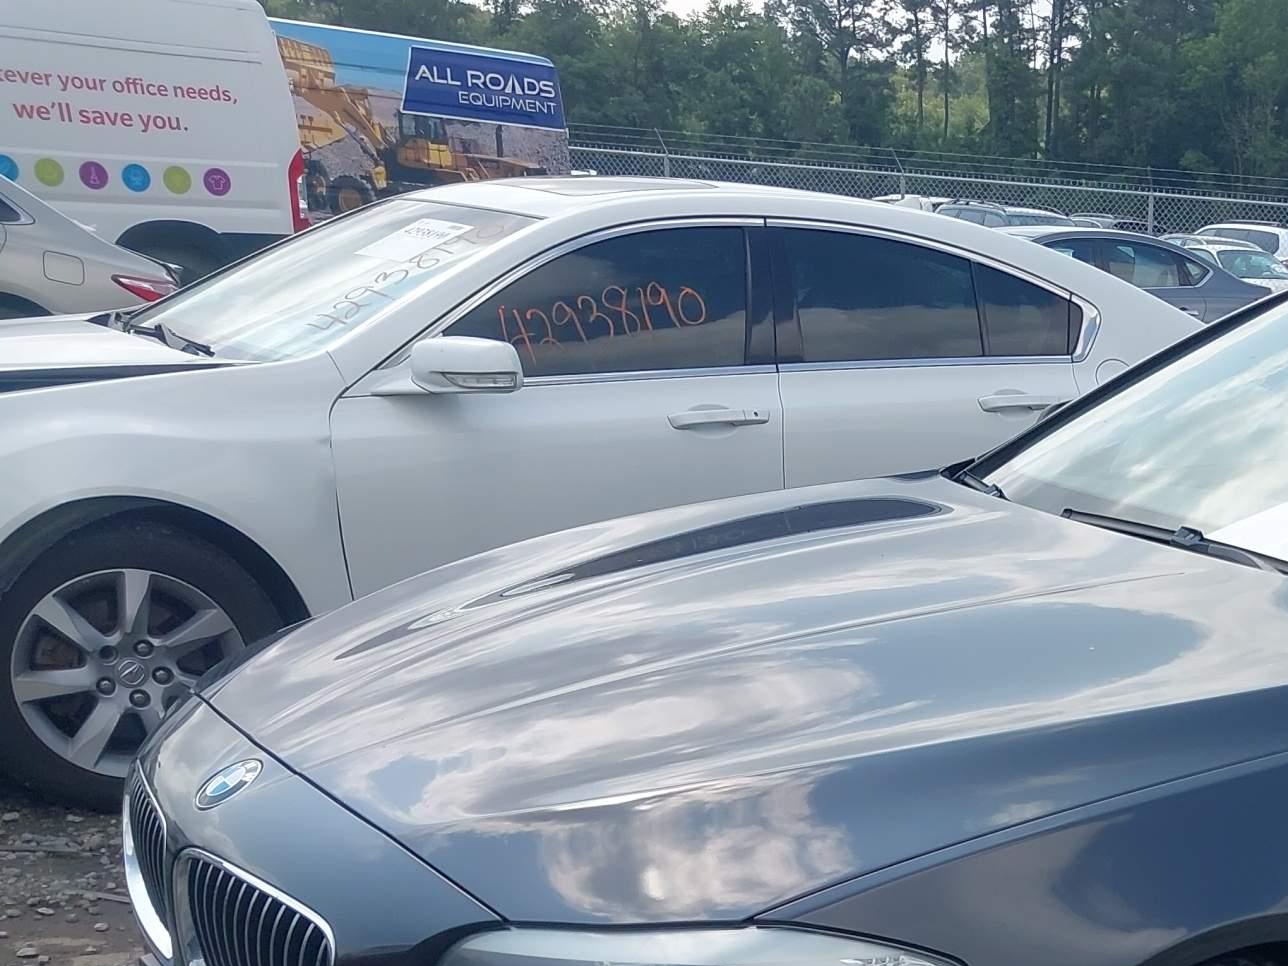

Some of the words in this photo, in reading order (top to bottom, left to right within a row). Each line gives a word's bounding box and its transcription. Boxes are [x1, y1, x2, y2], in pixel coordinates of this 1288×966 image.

[57, 73, 107, 92] your
[112, 77, 169, 97] office
[173, 84, 238, 104] needs,
[415, 64, 462, 86] ALL
[466, 70, 556, 98] ROADS
[458, 91, 557, 115] EQUIPMENT
[78, 108, 134, 127] save
[138, 113, 189, 132] you.
[498, 281, 707, 366] 42938190
